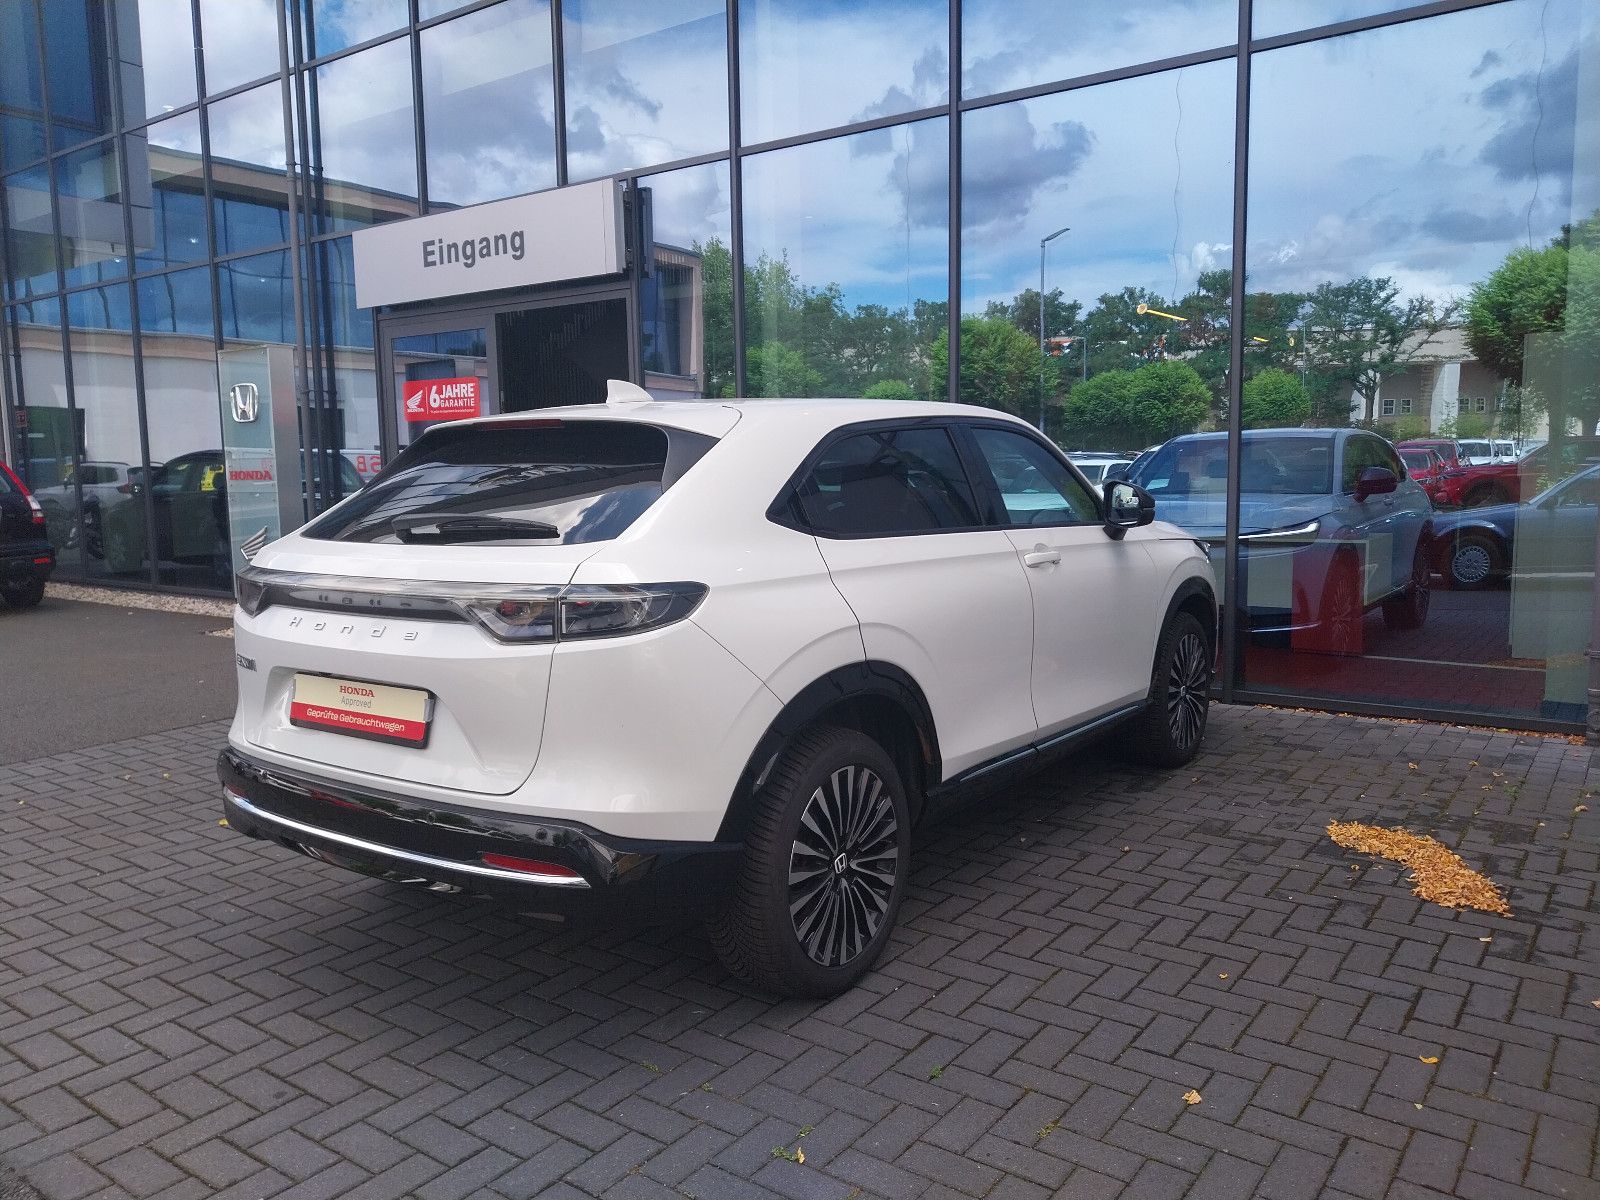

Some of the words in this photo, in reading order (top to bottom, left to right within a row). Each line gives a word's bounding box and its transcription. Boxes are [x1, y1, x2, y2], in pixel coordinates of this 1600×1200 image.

[422, 230, 525, 268] Eingang
[429, 385, 440, 408] 6
[440, 383, 475, 398] JAHRE
[440, 398, 475, 408] GARANTIE
[229, 470, 272, 481] HONDA
[289, 616, 419, 641] Honda
[339, 685, 375, 698] HONDA
[341, 697, 372, 708] Approved
[306, 708, 339, 721] Geprüfte
[339, 713, 405, 733] Gebrauchtwagen
